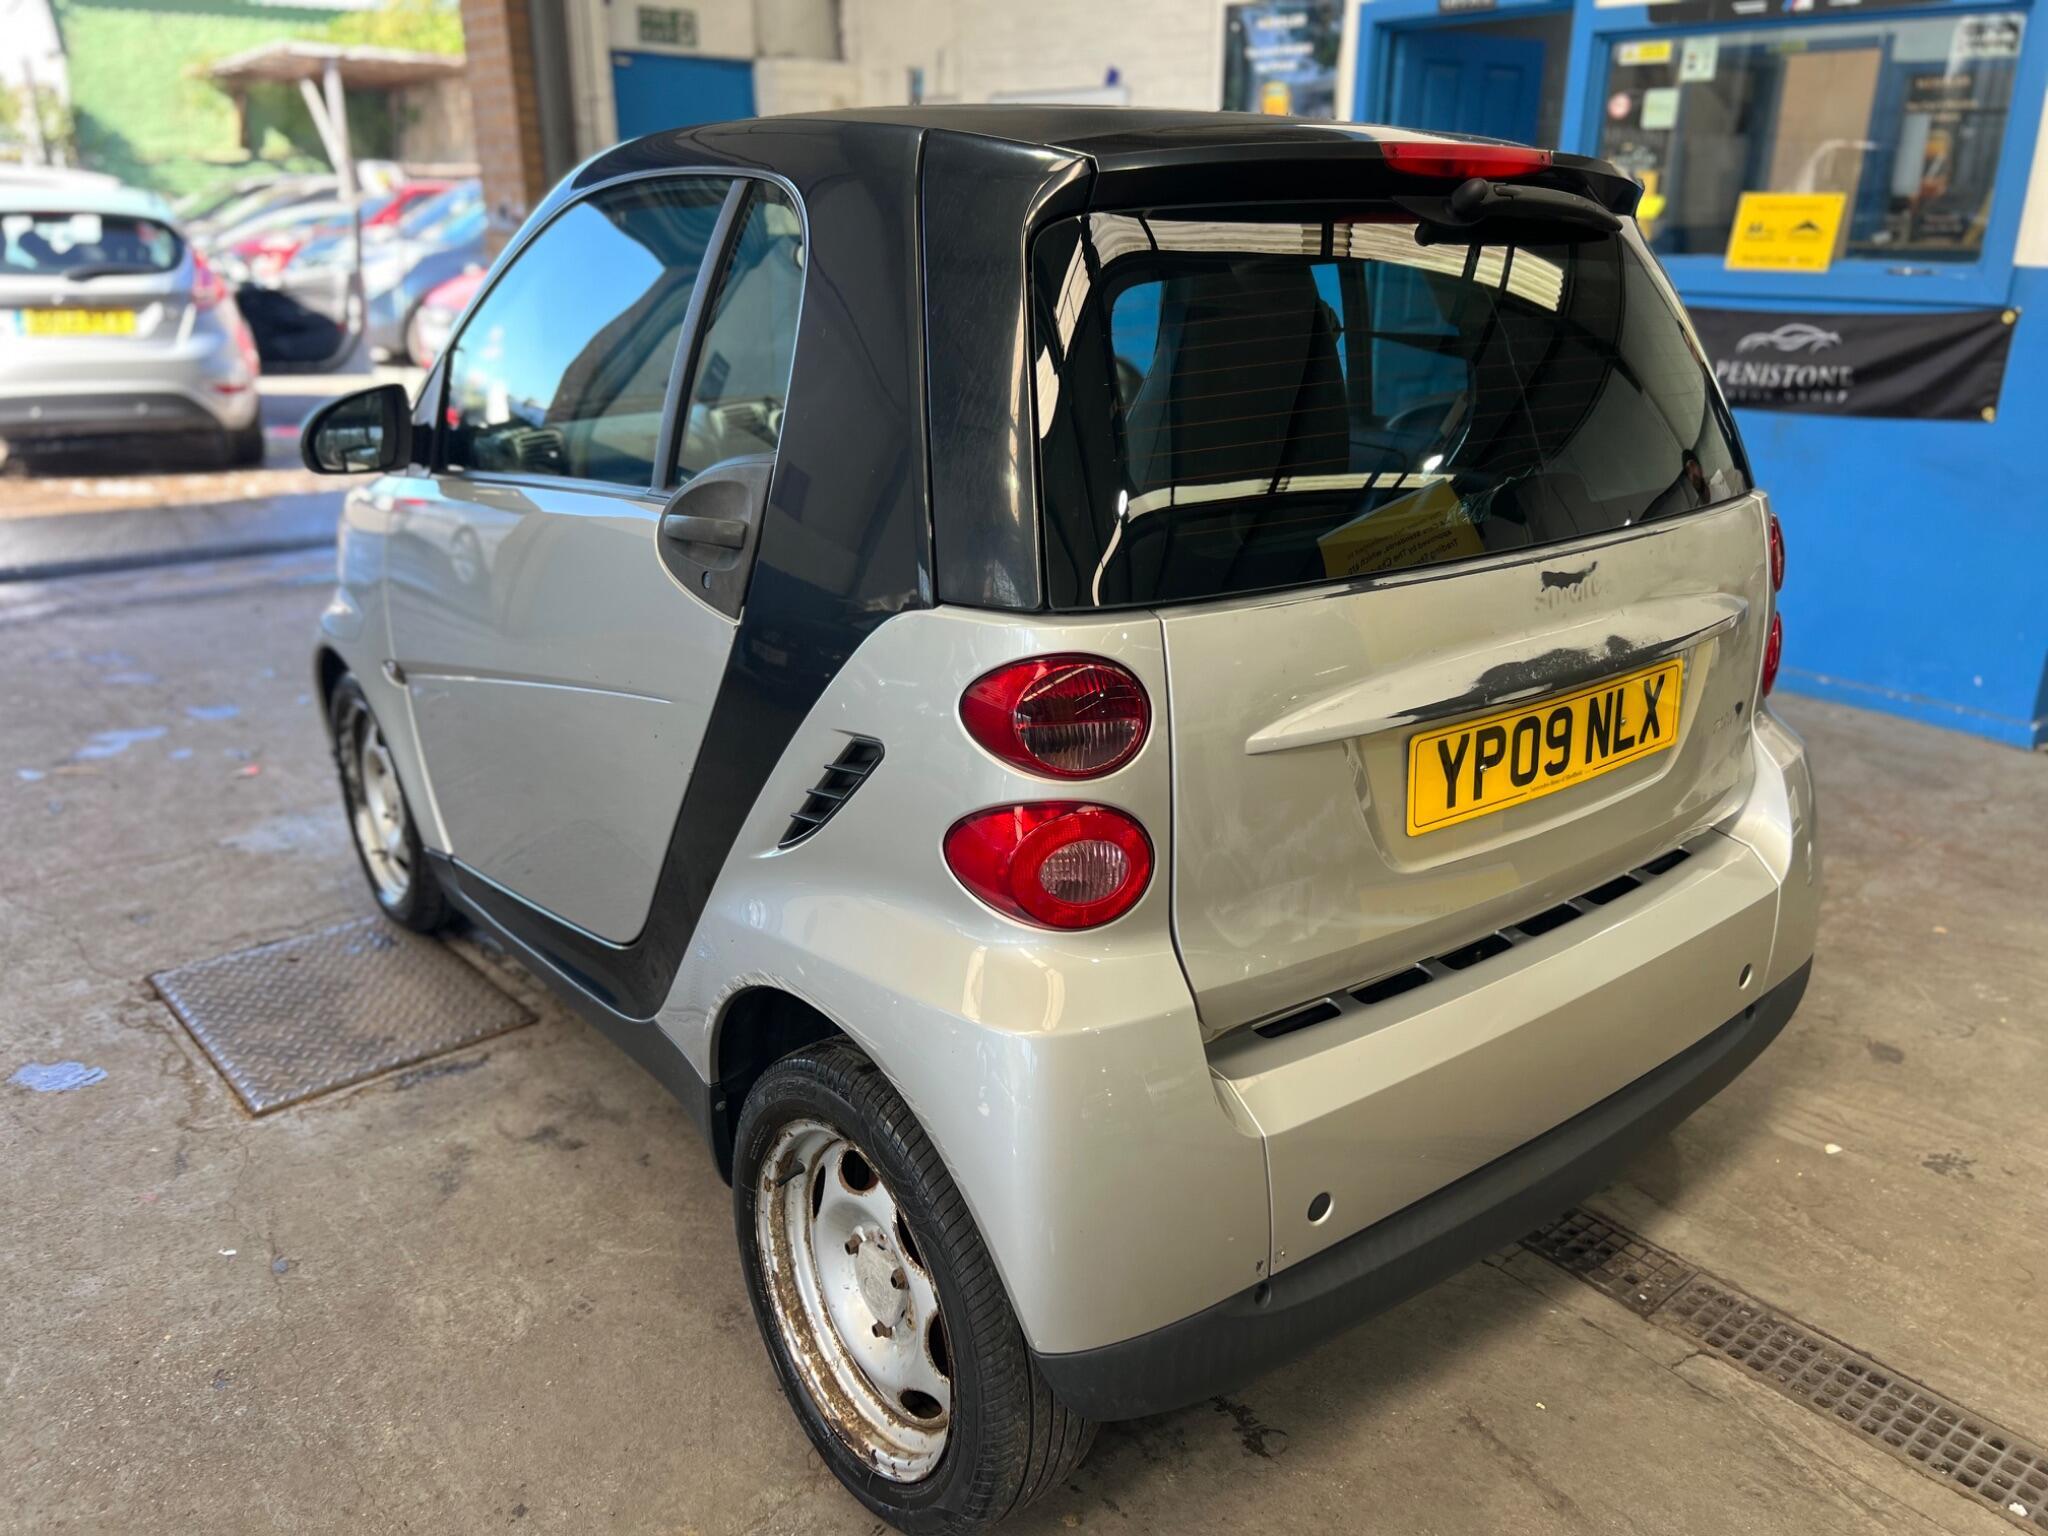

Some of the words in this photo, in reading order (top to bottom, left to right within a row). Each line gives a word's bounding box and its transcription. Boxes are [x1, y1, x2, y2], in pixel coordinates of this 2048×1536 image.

[1716, 360, 1853, 387] PENISTONE
[1438, 706, 1573, 809] YP09
[1585, 674, 1665, 764] NLX
